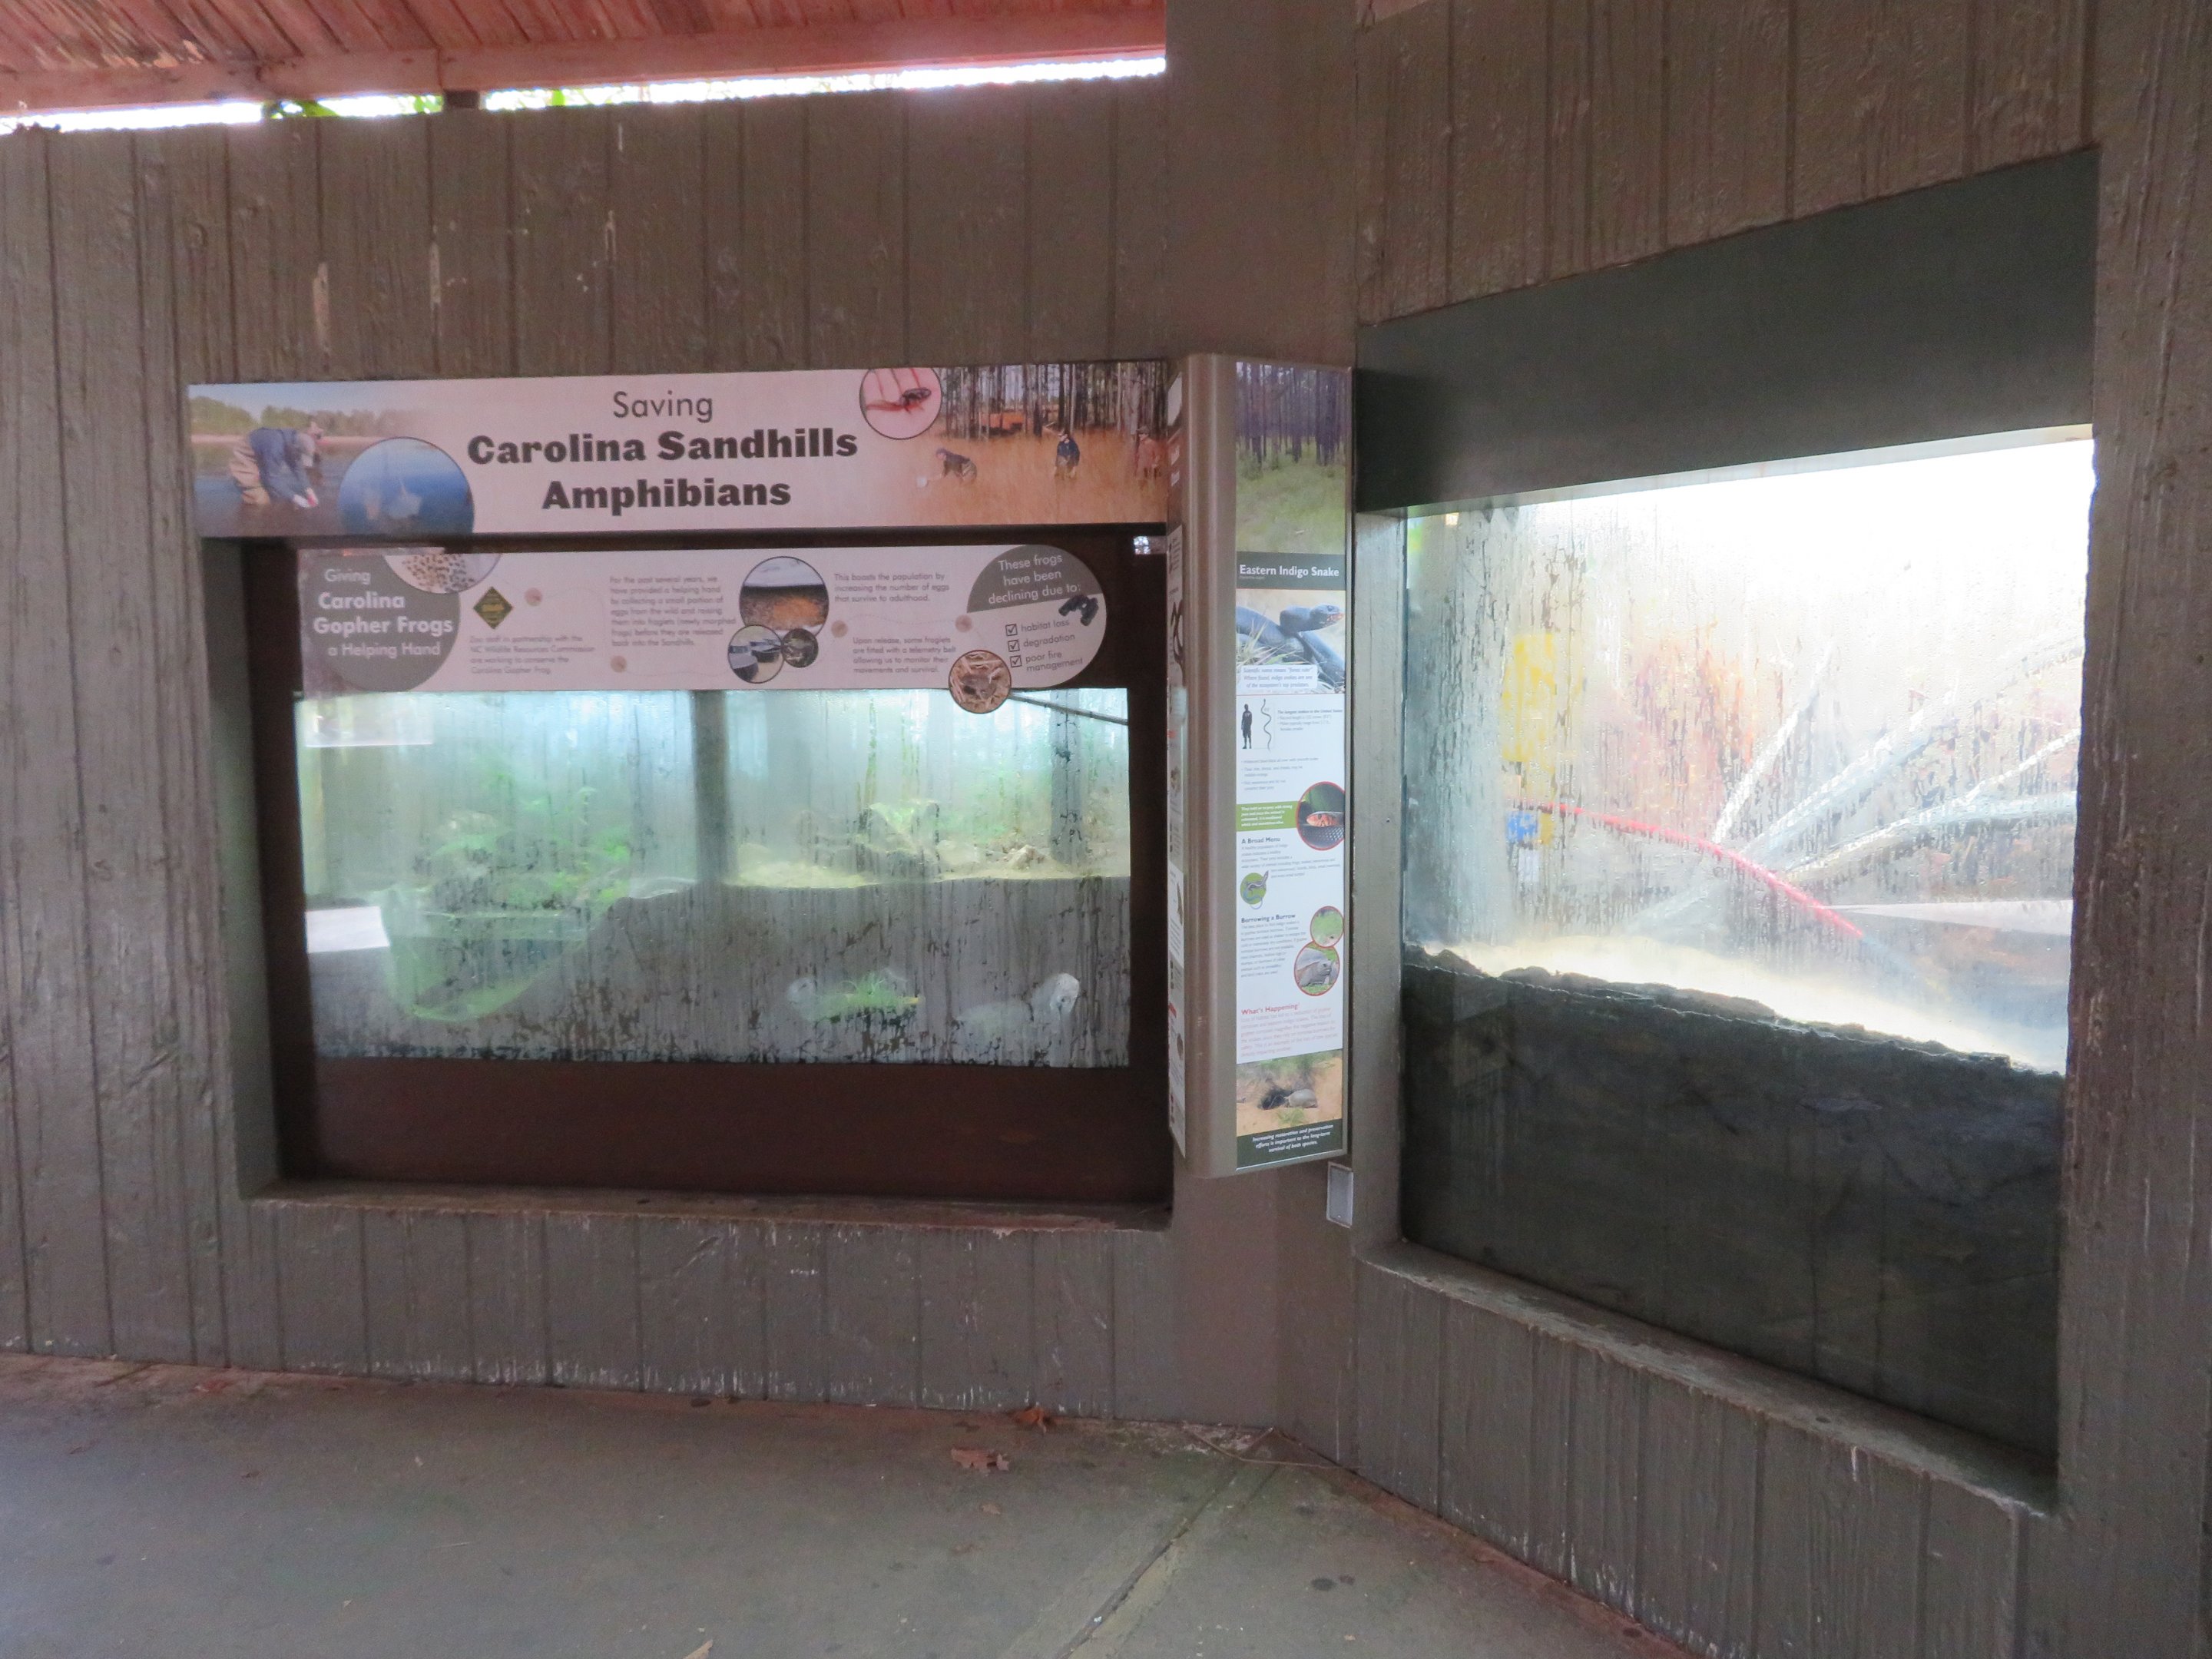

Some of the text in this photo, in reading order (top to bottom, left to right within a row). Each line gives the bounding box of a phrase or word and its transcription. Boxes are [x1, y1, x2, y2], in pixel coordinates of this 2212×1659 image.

[613, 390, 713, 423] Saving
[467, 427, 859, 465] Carolina Sandhills
[541, 477, 792, 515] Amphibians
[998, 554, 1064, 571] These frogs
[1239, 564, 1277, 575] Eastern
[1279, 565, 1310, 578] Indigo
[1310, 566, 1340, 577] Snake
[324, 568, 372, 585] Giving
[1002, 570, 1062, 587] have been
[317, 590, 406, 609] Carolina
[987, 588, 1039, 605] declining
[1041, 584, 1064, 597] due
[313, 615, 454, 639] Gopher Frogs
[1020, 618, 1071, 633] habitat loss
[1022, 633, 1076, 648] degradation
[327, 641, 442, 660] a Helping Hand
[1025, 650, 1063, 664] poor fire
[1026, 657, 1084, 673] management
